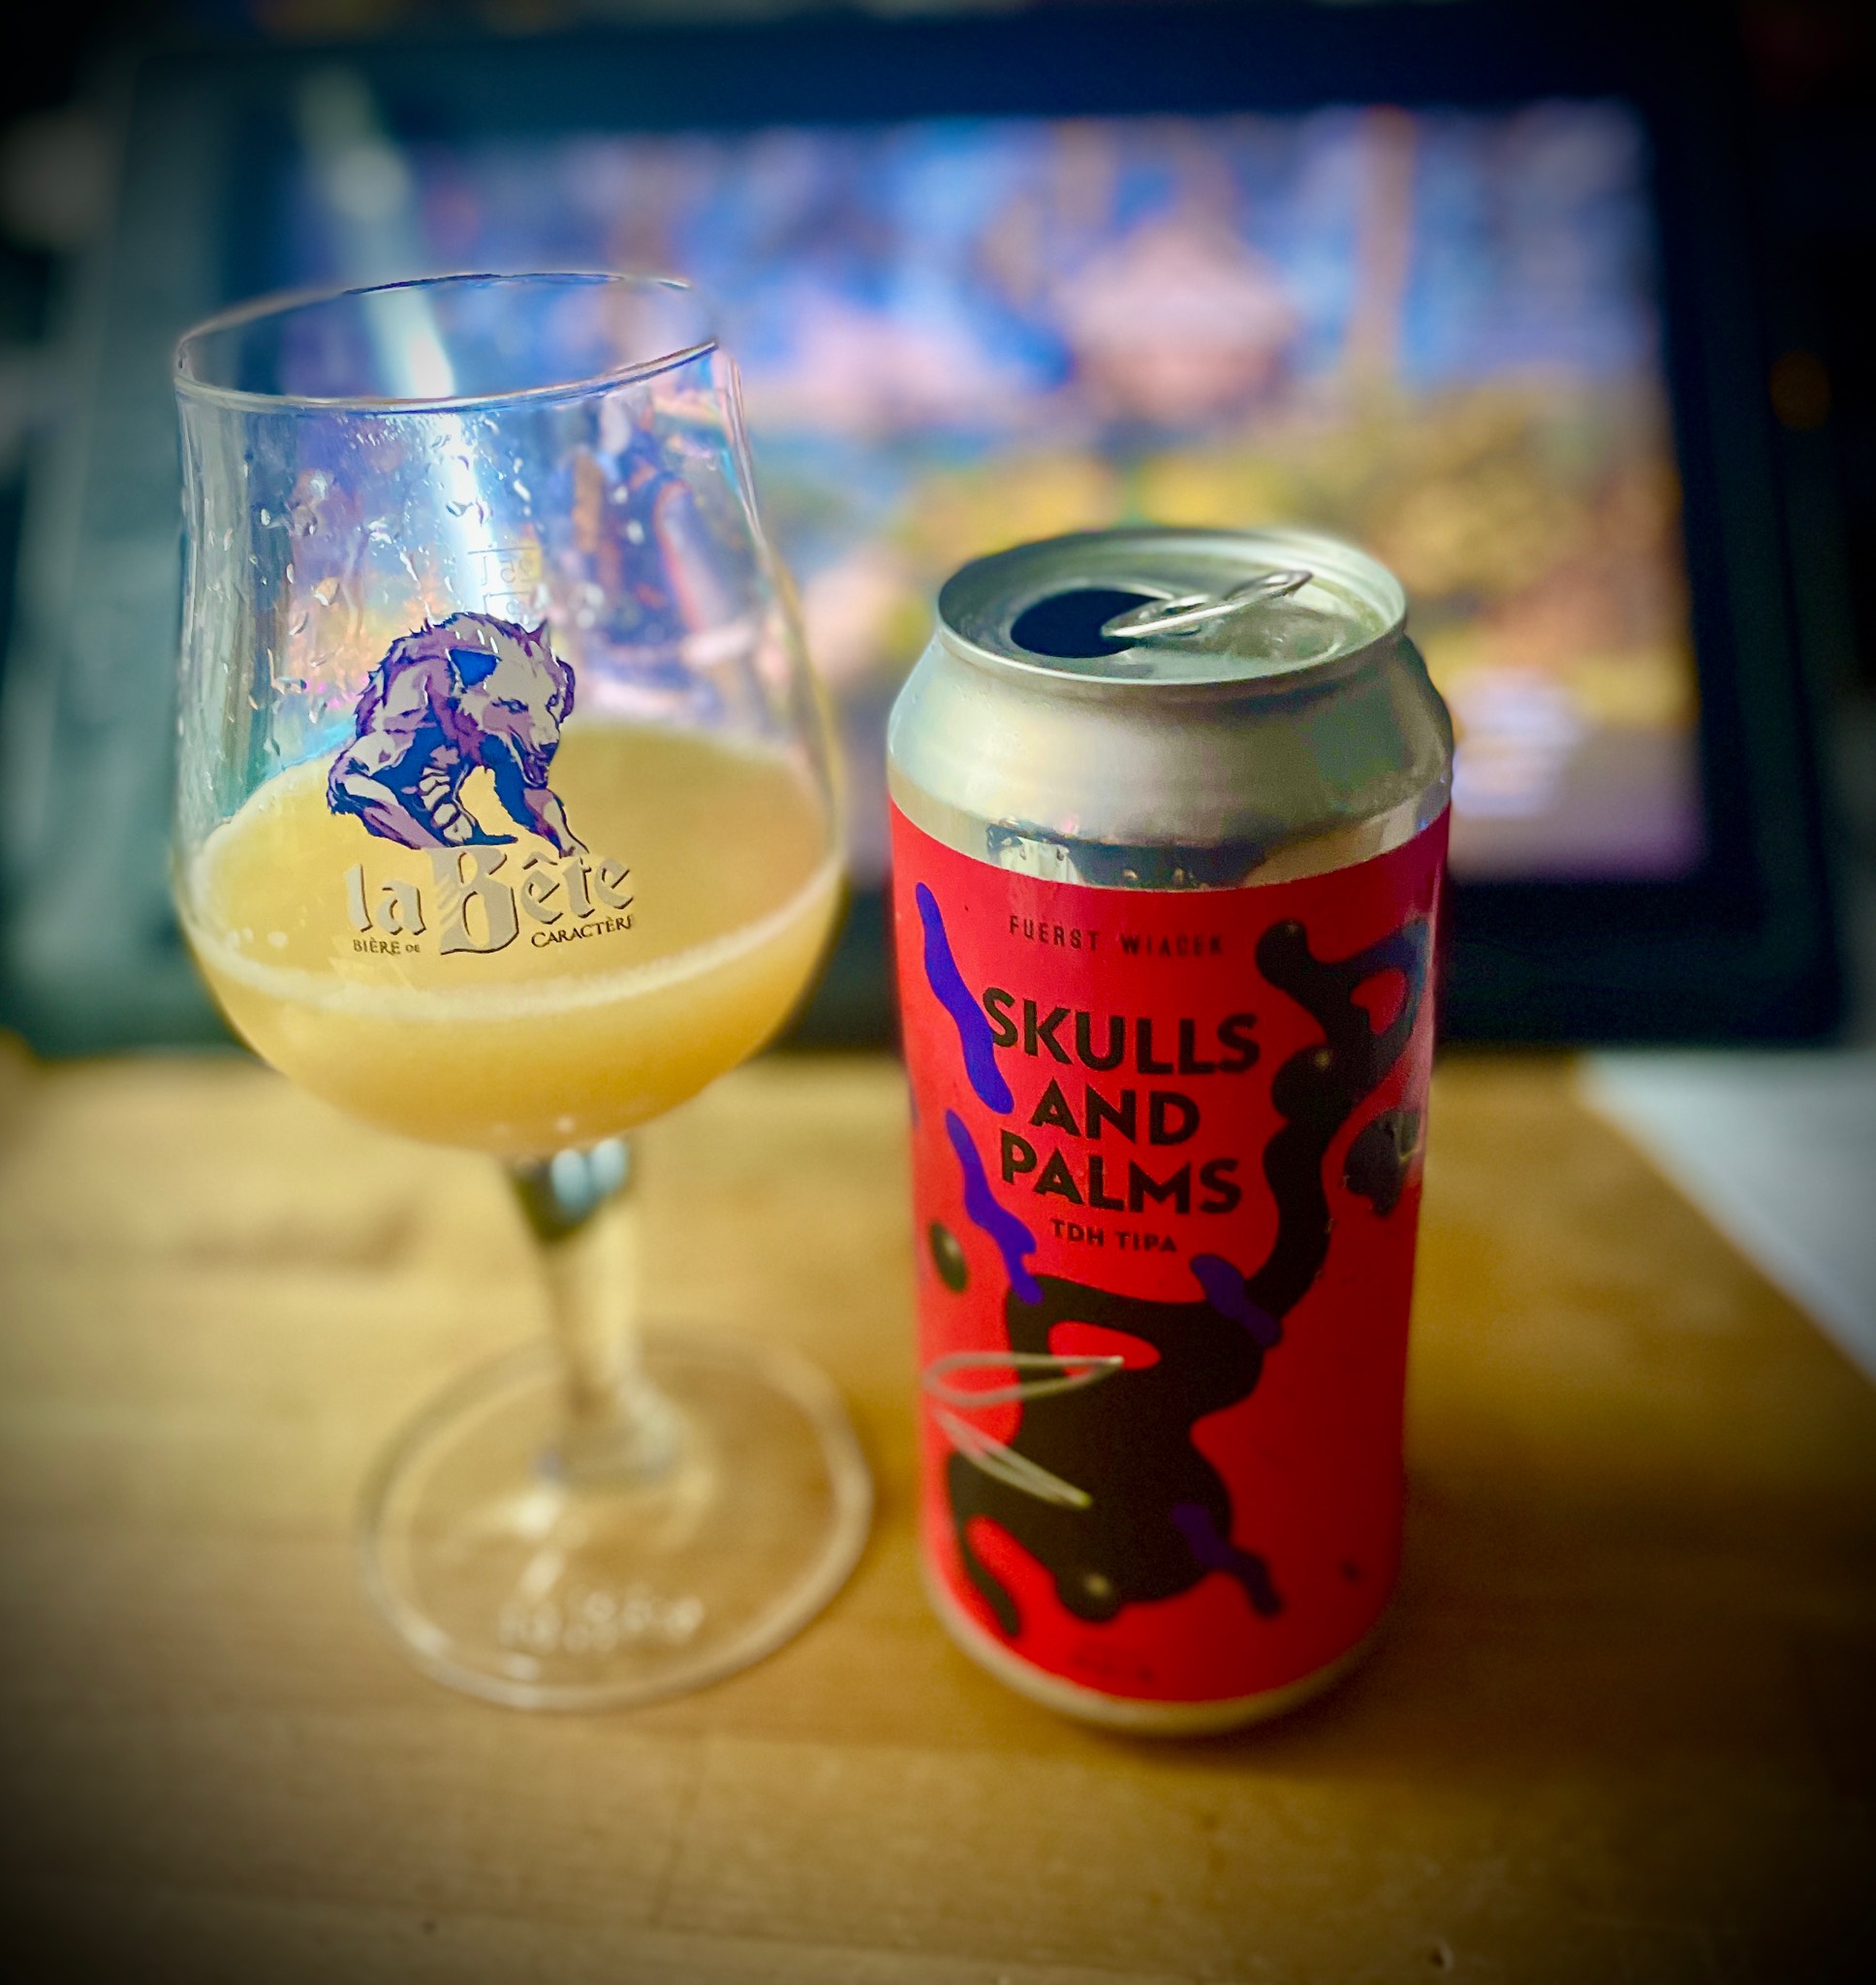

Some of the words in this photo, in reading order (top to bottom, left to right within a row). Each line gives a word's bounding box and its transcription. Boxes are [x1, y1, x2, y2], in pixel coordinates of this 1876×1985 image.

[344, 862, 426, 935] la
[422, 846, 635, 956] Bête
[1010, 915, 1100, 953] FUERST
[353, 936, 401, 956] BIÈRE
[405, 944, 421, 954] DE
[983, 987, 1261, 1075] SKULLS
[1029, 1076, 1201, 1146] AND
[1000, 1128, 1242, 1214] PALMS
[1050, 1217, 1105, 1247] TDH
[1115, 1231, 1177, 1252] TIPA
